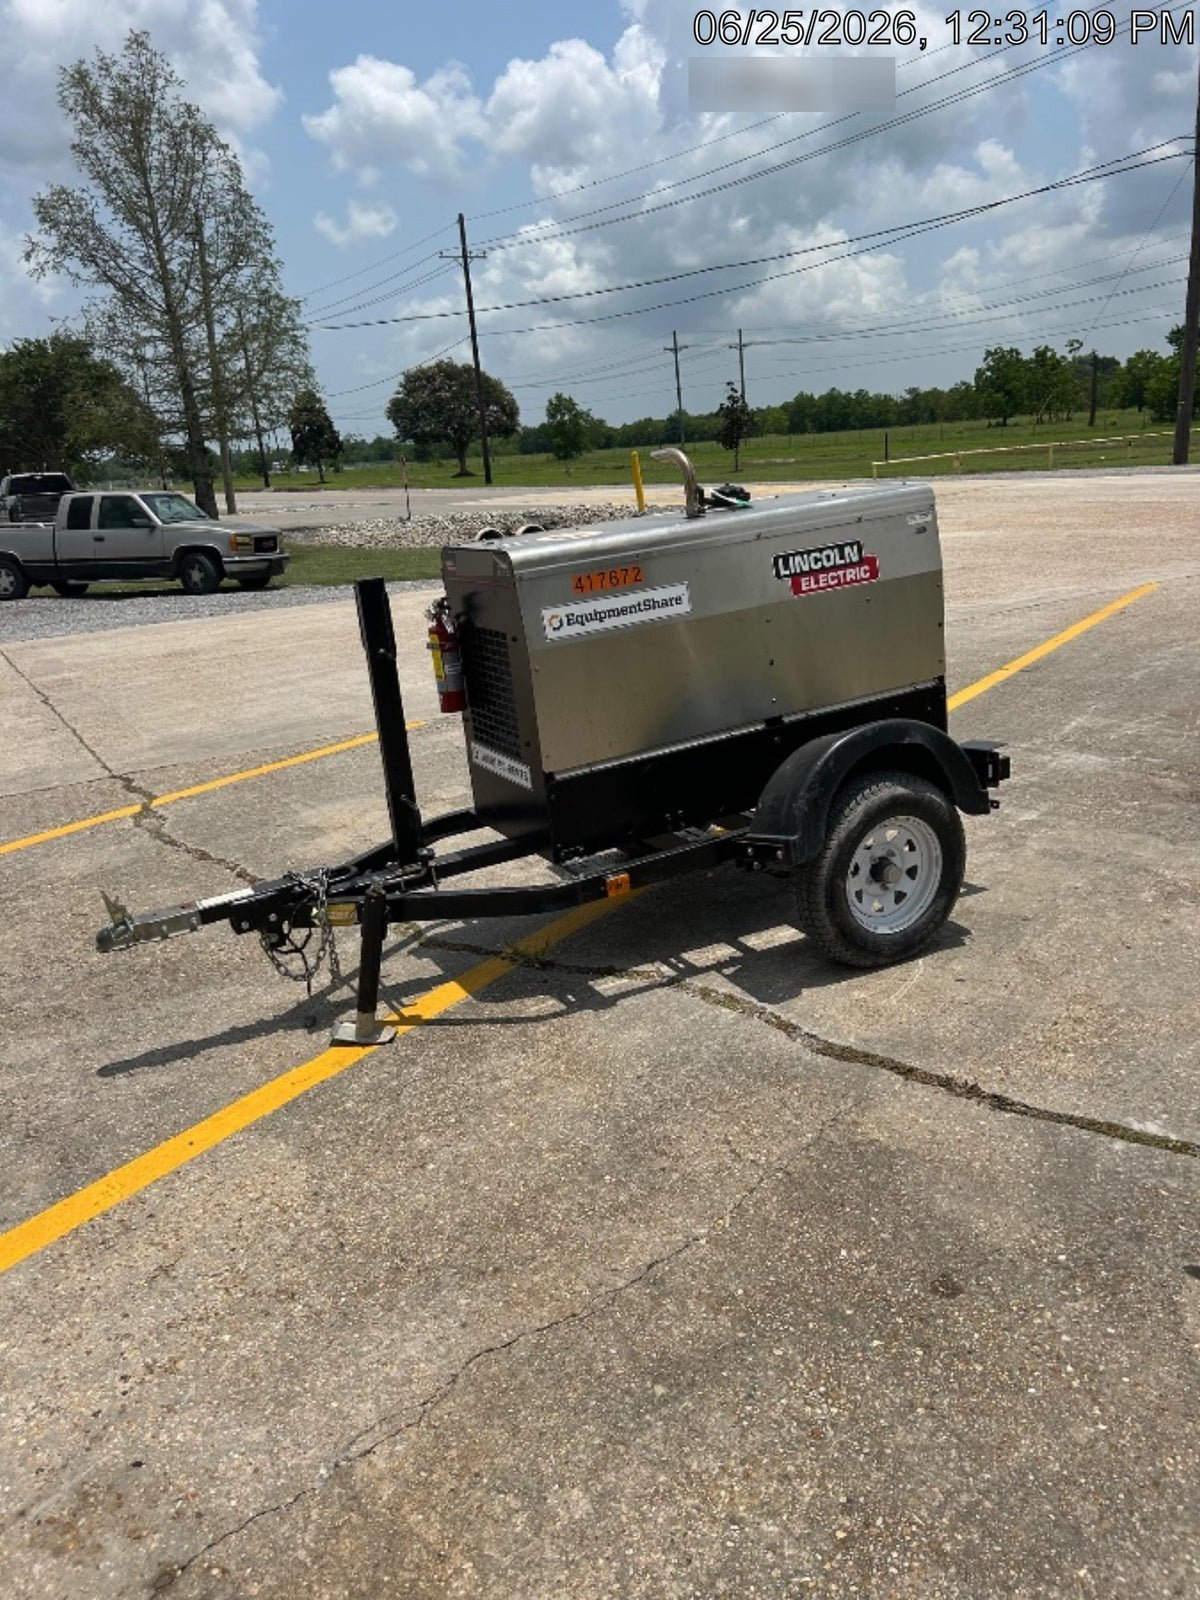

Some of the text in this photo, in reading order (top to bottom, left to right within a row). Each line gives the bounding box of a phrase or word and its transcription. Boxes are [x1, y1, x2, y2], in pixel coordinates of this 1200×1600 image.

[778, 544, 860, 576] LINCOLN
[574, 566, 643, 593] 417672
[801, 565, 870, 591] ELECTRIC
[565, 595, 683, 627] EquipmentShare
